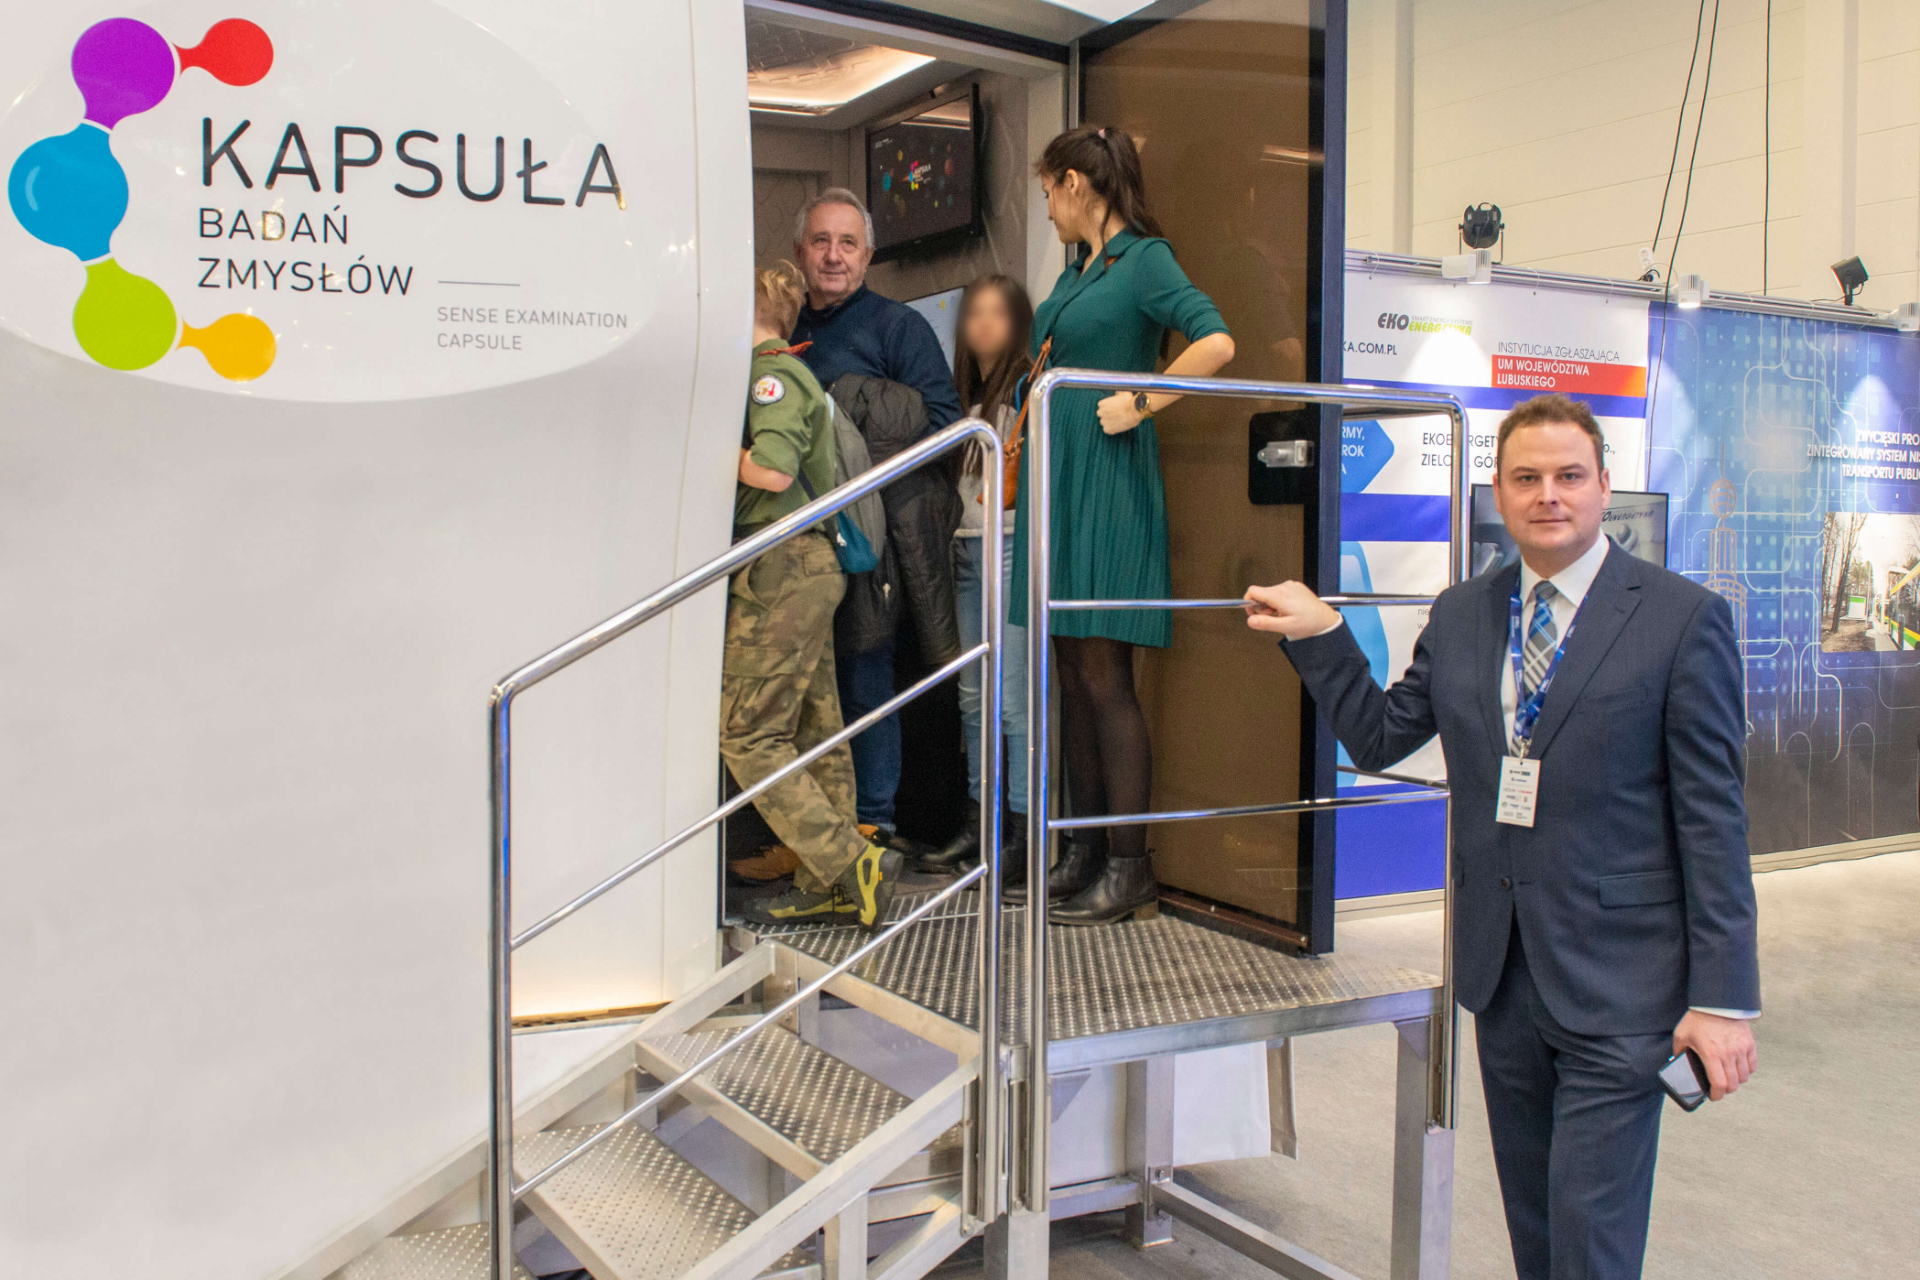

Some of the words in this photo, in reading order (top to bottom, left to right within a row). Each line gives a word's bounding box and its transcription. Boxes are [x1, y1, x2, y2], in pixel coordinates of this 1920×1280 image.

[202, 117, 628, 211] KAPSUŁA
[198, 205, 348, 245] BADAŃ
[198, 254, 414, 296] ZMYSŁÓW
[437, 306, 498, 323] SENSE
[505, 309, 627, 328] EXAMINATION
[1377, 312, 1410, 331] EKO
[437, 333, 523, 350] CAPSULE
[1498, 341, 1553, 357] INSTYTUCJA
[1555, 346, 1620, 364] ZGŁASZAJĄCA
[1498, 358, 1513, 371] UM
[1516, 360, 1590, 376] WOJEWÓDZTWA
[1497, 373, 1556, 388] LUBUSKIEGO
[1856, 429, 1900, 447] ZWYCIĘSKI
[1806, 444, 1876, 460] ZINTEGROWANY
[1876, 449, 1908, 462] SYSTEM
[1842, 464, 1895, 480] TRANSPORTU
[1896, 467, 1920, 480] PUBLI
